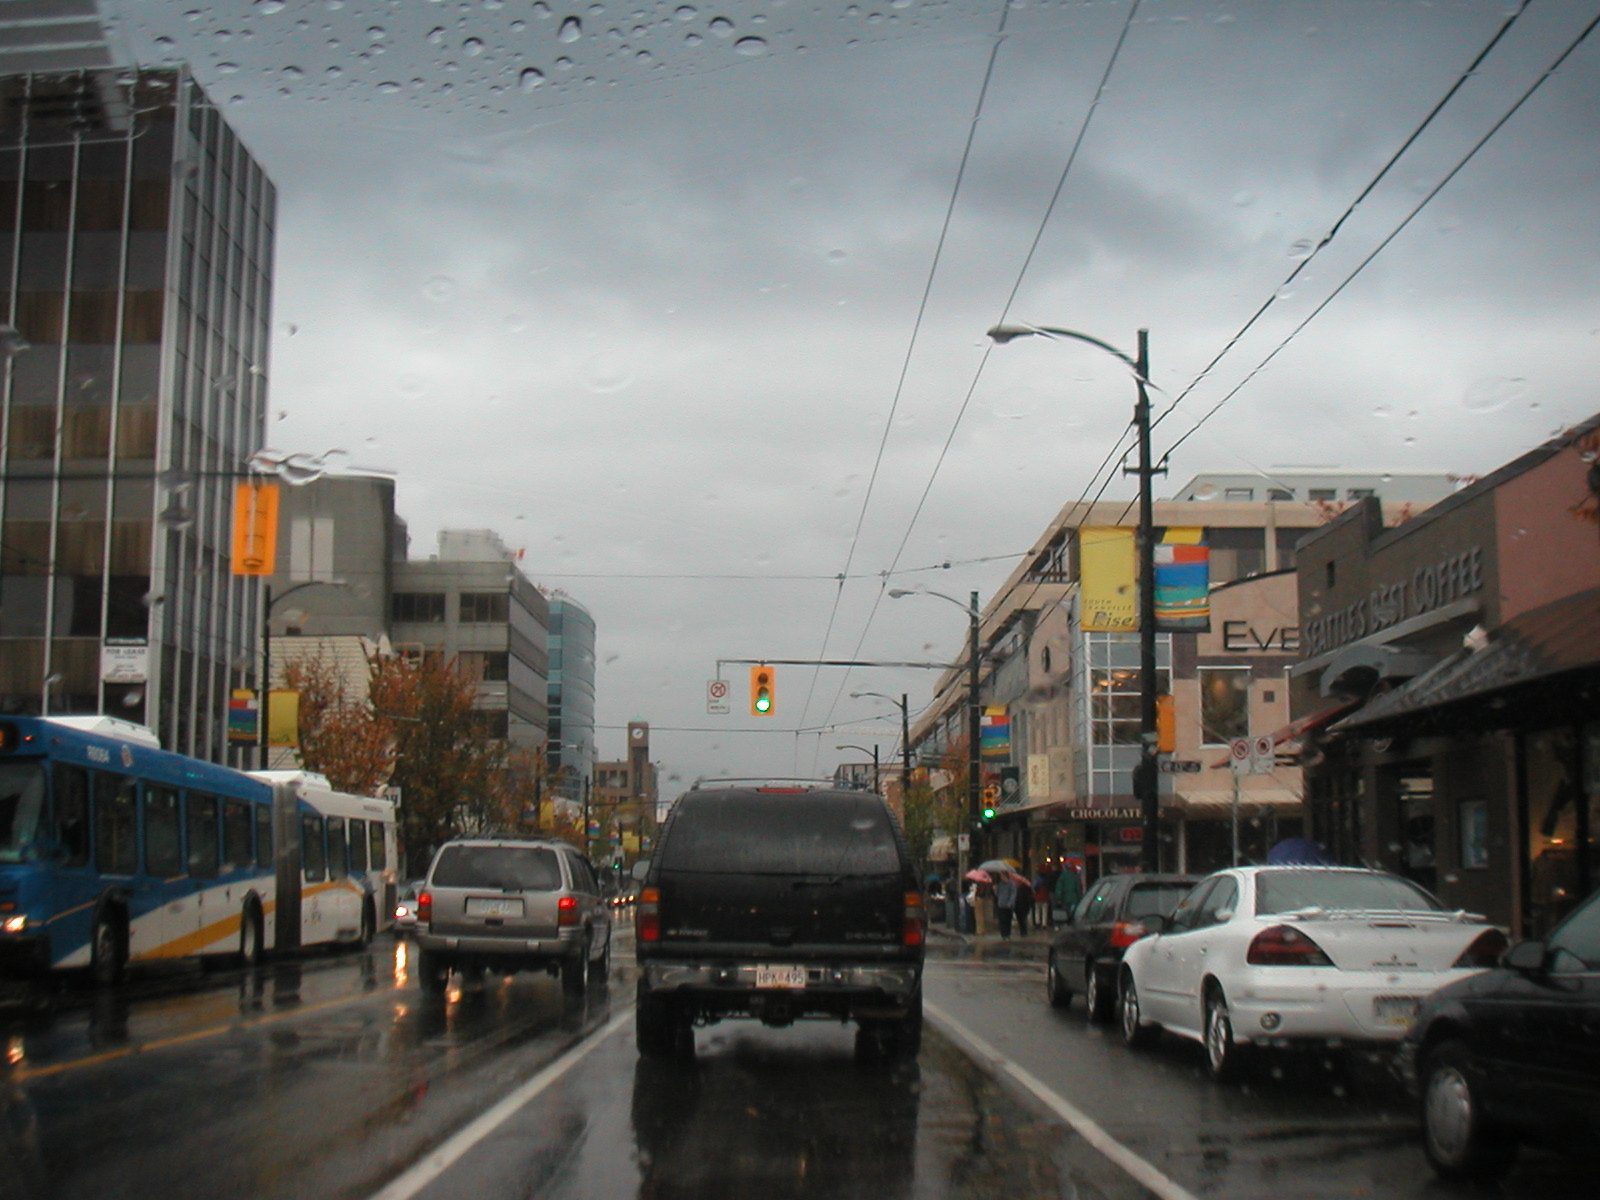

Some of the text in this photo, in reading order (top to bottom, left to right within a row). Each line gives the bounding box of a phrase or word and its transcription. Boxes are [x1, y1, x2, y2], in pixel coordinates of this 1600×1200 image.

[1412, 547, 1484, 614] COFFEE
[1092, 611, 1133, 627] Rise
[1223, 620, 1299, 652] EVE
[785, 971, 804, 983] 495
